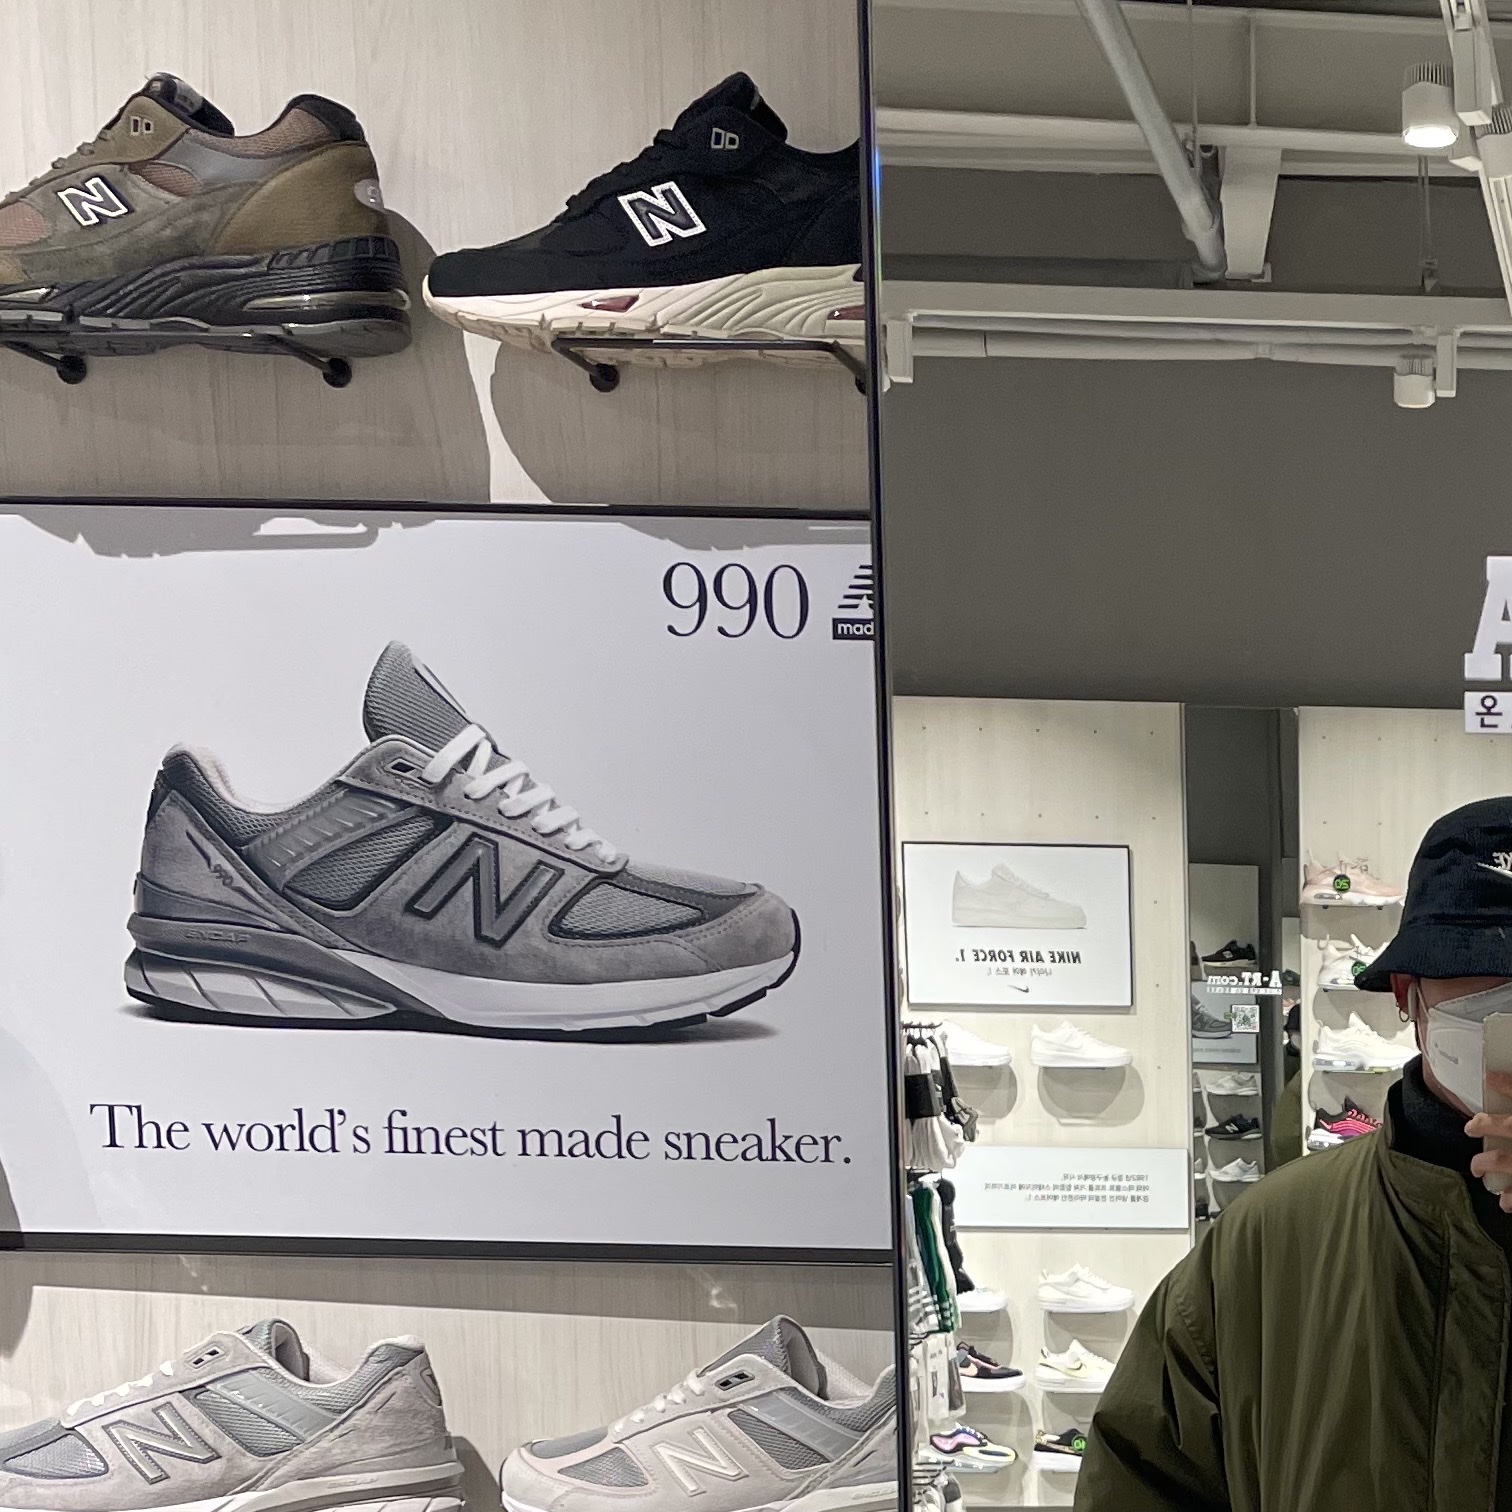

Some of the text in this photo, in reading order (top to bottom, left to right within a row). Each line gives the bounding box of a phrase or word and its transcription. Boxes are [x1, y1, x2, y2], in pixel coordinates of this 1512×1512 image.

[618, 181, 706, 246] N
[662, 562, 809, 639] 990
[89, 1103, 852, 1165] The world's finest made sneaker.
